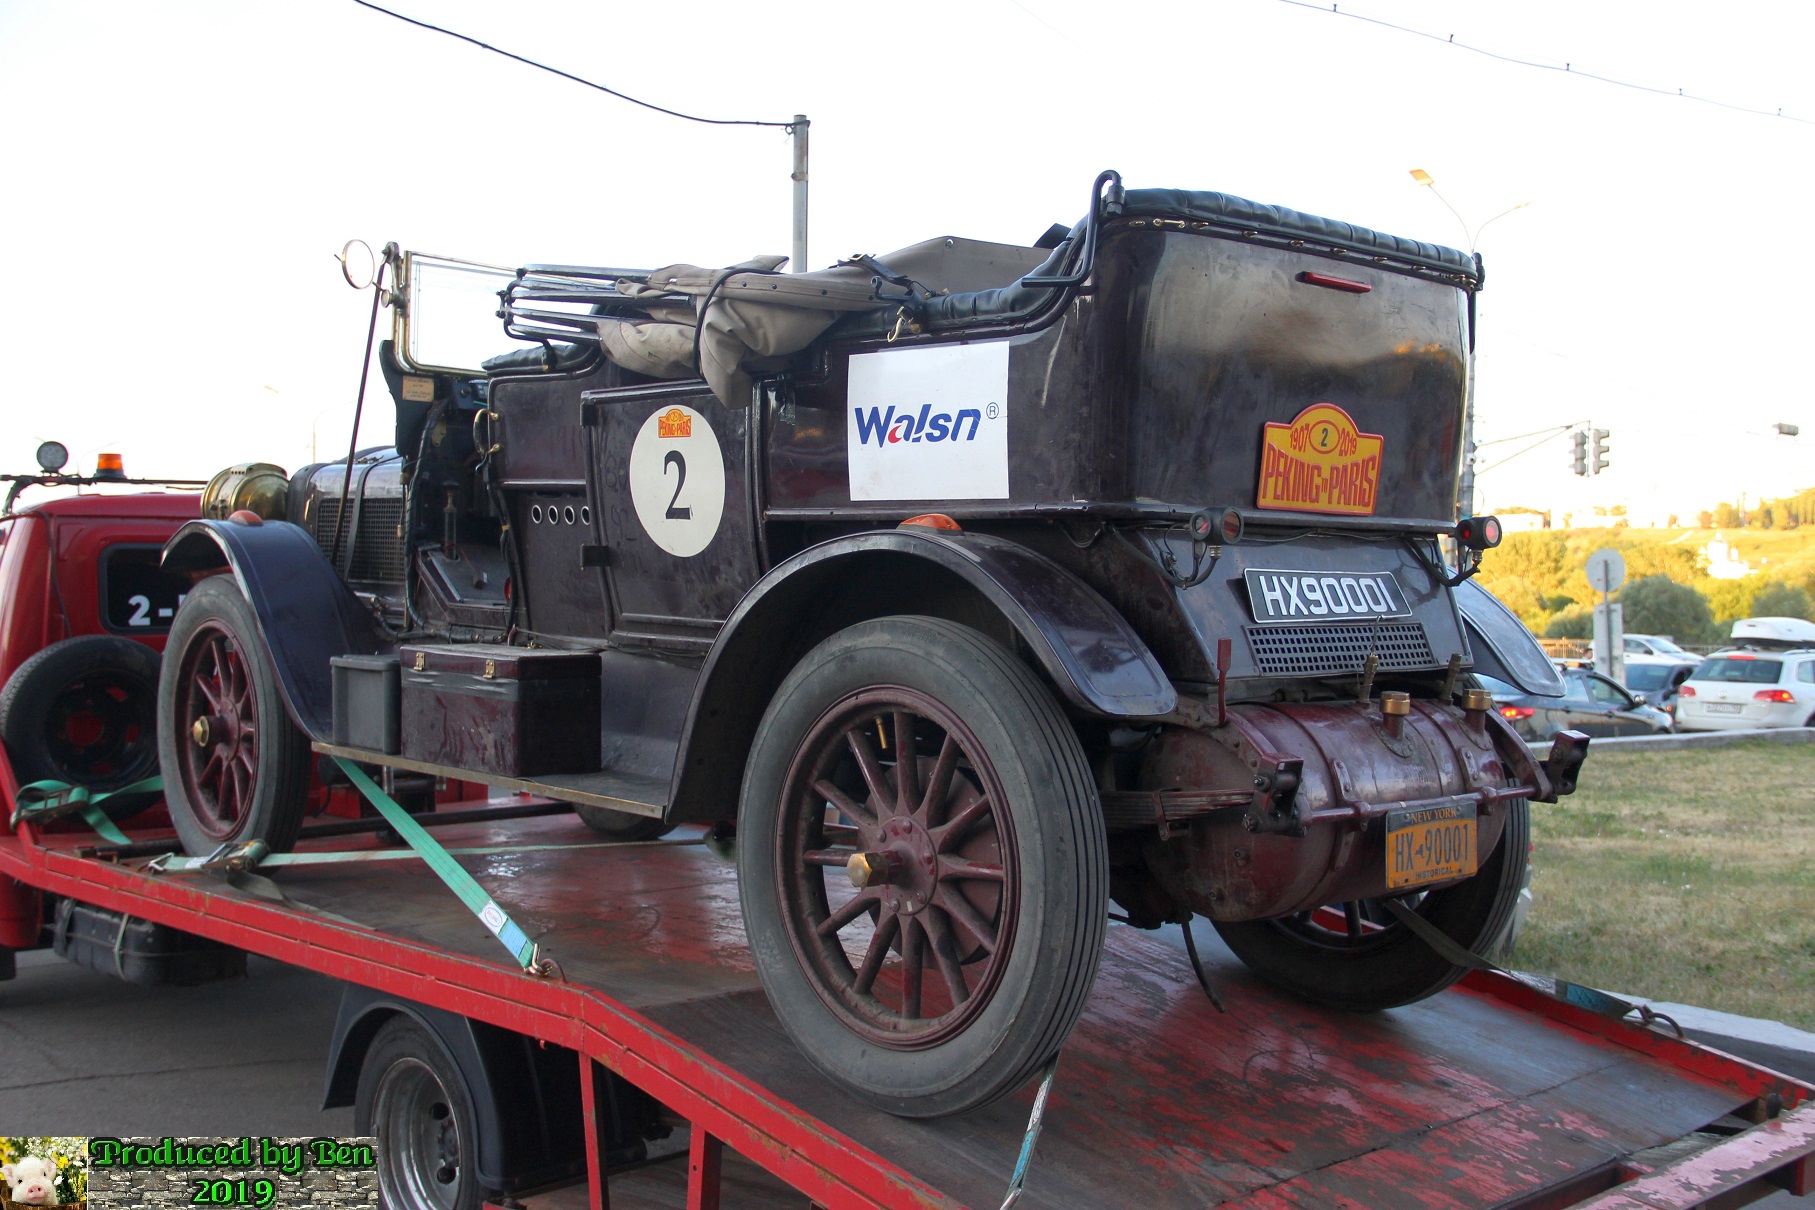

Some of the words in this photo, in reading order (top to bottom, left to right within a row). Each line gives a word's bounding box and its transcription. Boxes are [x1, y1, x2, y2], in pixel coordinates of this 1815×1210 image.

[854, 403, 982, 448] Walsn
[1289, 423, 1310, 453] 1907
[1319, 428, 1329, 447] 2
[1338, 427, 1358, 456] 2019
[664, 450, 690, 520] 2
[1262, 442, 1323, 503] PEKING
[1327, 453, 1378, 507] PARIS
[1258, 575, 1398, 616] HX90001
[1411, 811, 1433, 824] NEW
[1434, 808, 1458, 820] YORK
[1395, 832, 1414, 872] HX
[1425, 824, 1469, 866] 90001
[1415, 866, 1454, 880] HISTORICAL
